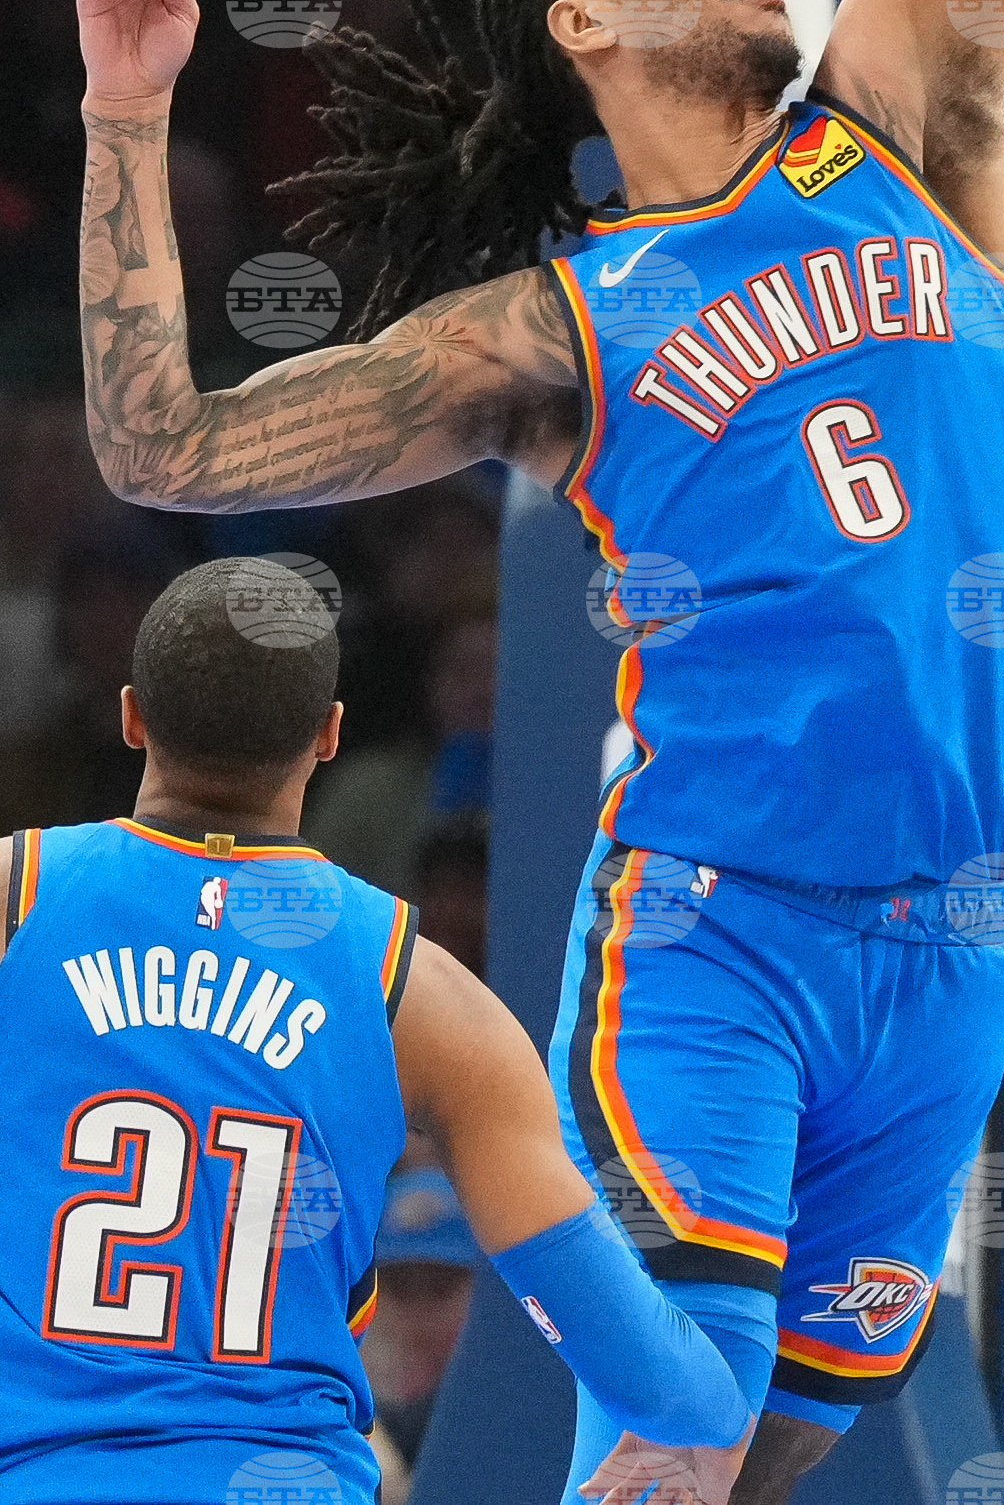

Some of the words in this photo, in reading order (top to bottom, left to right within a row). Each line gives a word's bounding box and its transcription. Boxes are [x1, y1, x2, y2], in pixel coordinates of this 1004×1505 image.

[630, 236, 953, 443] THUNDER
[801, 398, 911, 543] 6
[61, 944, 327, 1070] WIGGINS
[41, 1088, 303, 1364] 21
[836, 1281, 915, 1308] OKC
